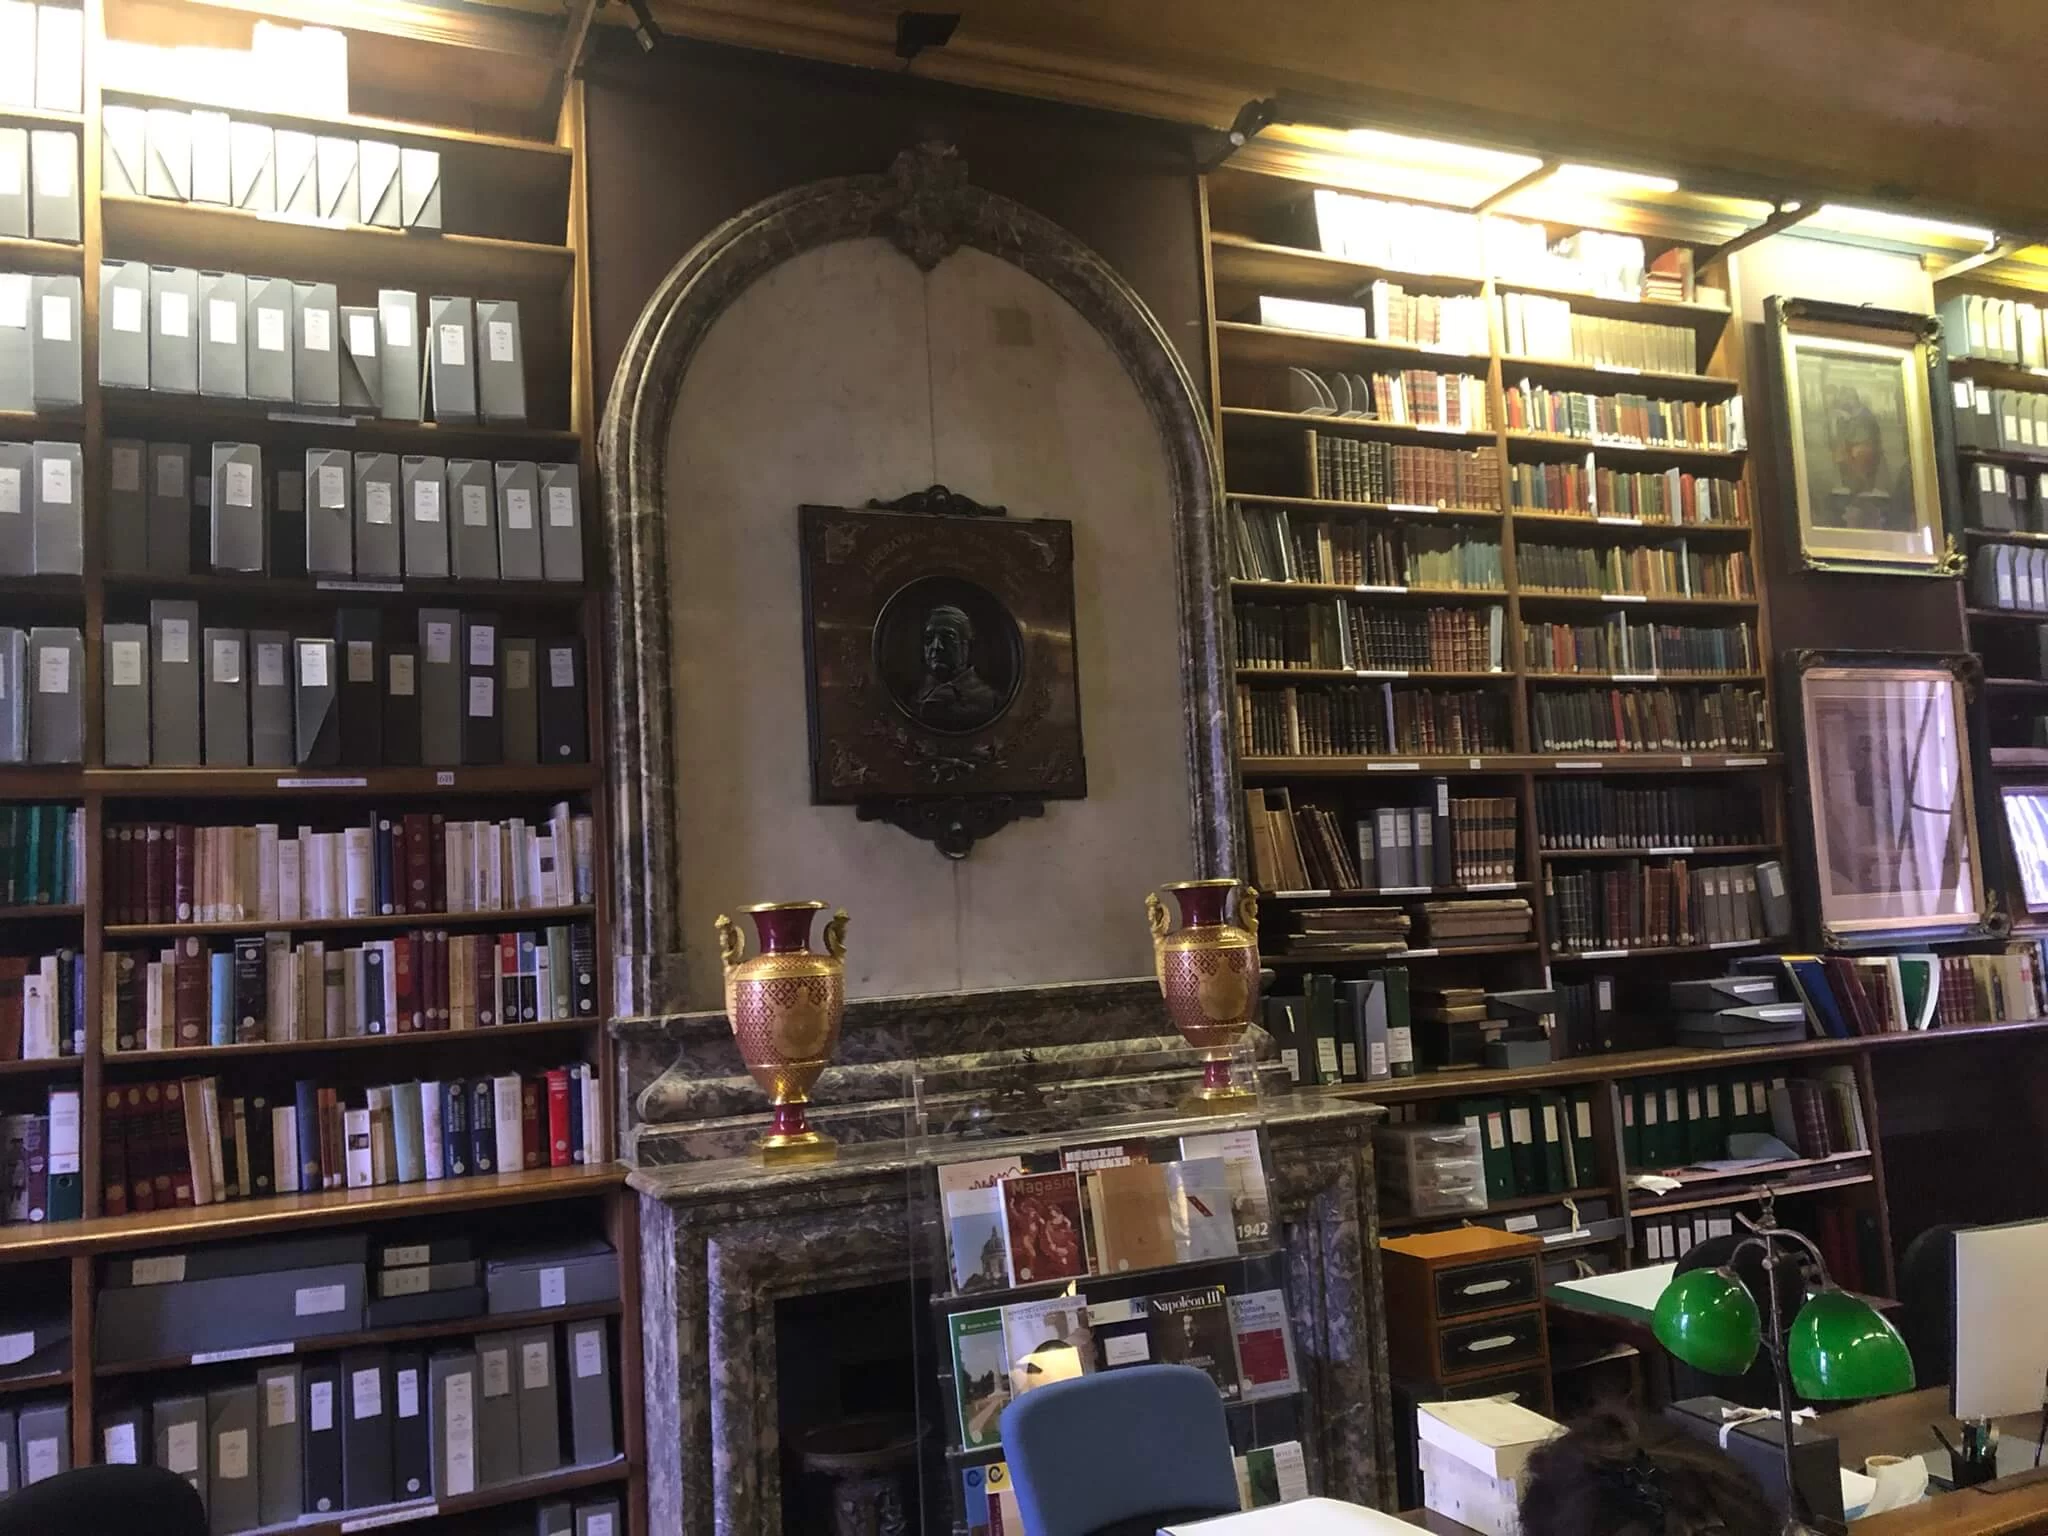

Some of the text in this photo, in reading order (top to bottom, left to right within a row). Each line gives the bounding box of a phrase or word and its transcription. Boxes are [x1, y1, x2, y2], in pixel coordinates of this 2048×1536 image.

[1010, 1174, 1077, 1197] Magasin
[1237, 1222, 1269, 1238] 1942
[1136, 1302, 1145, 1313] N
[1152, 1289, 1221, 1315] Napoléon III
